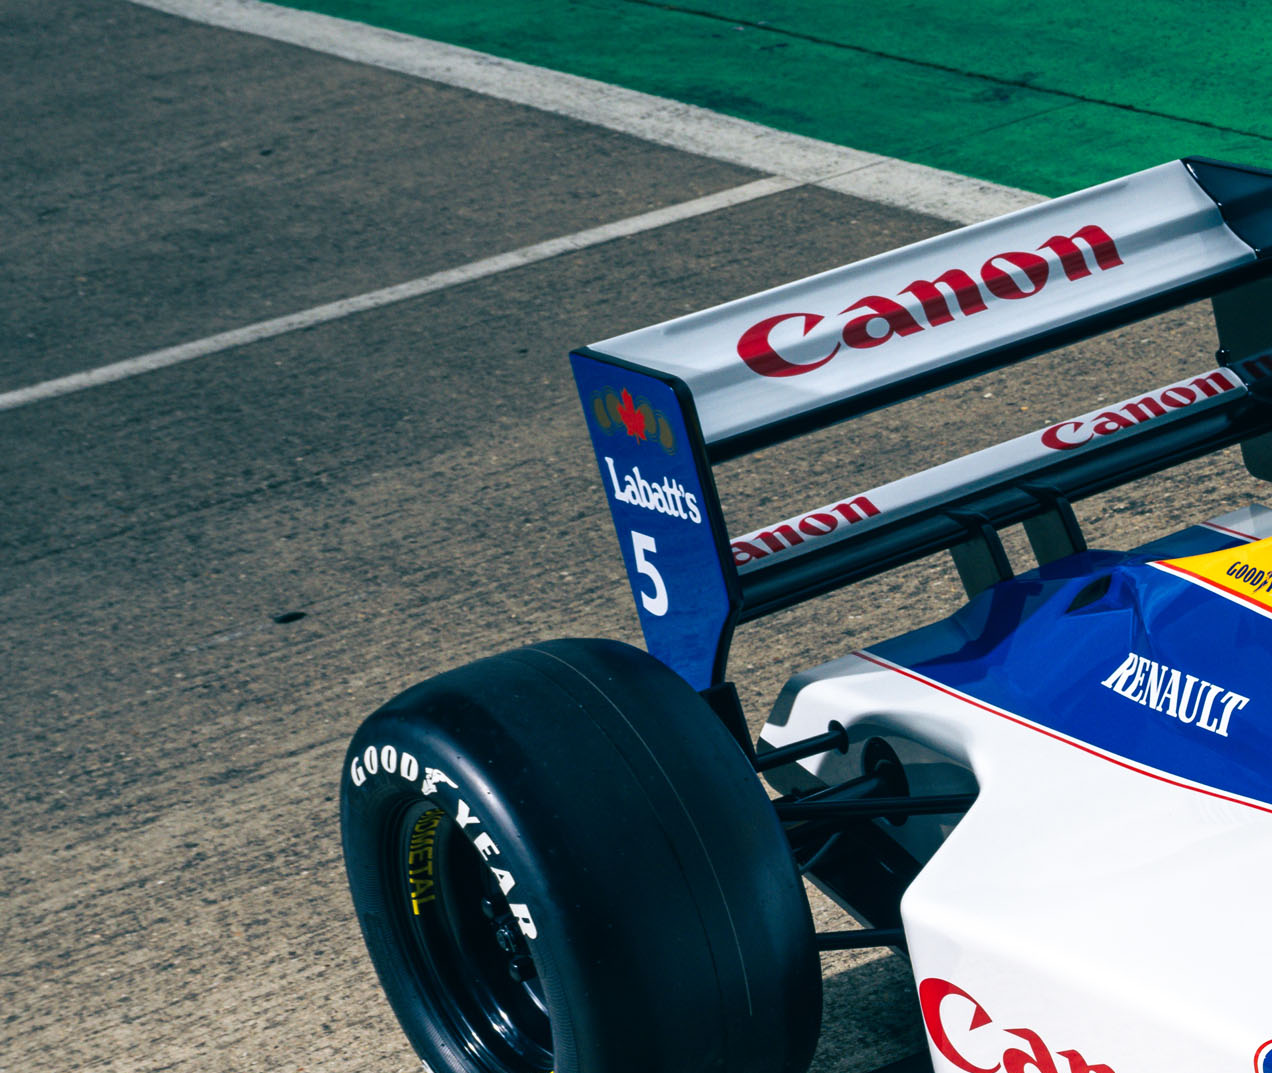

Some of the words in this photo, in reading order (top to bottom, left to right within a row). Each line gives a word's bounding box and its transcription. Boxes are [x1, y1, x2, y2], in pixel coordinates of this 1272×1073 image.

[737, 225, 1123, 377] Canon
[1041, 367, 1236, 451] Canon
[604, 457, 702, 526] Labatt's
[731, 496, 880, 566] anon
[629, 530, 669, 617] 5
[1101, 652, 1250, 737] RENAULT
